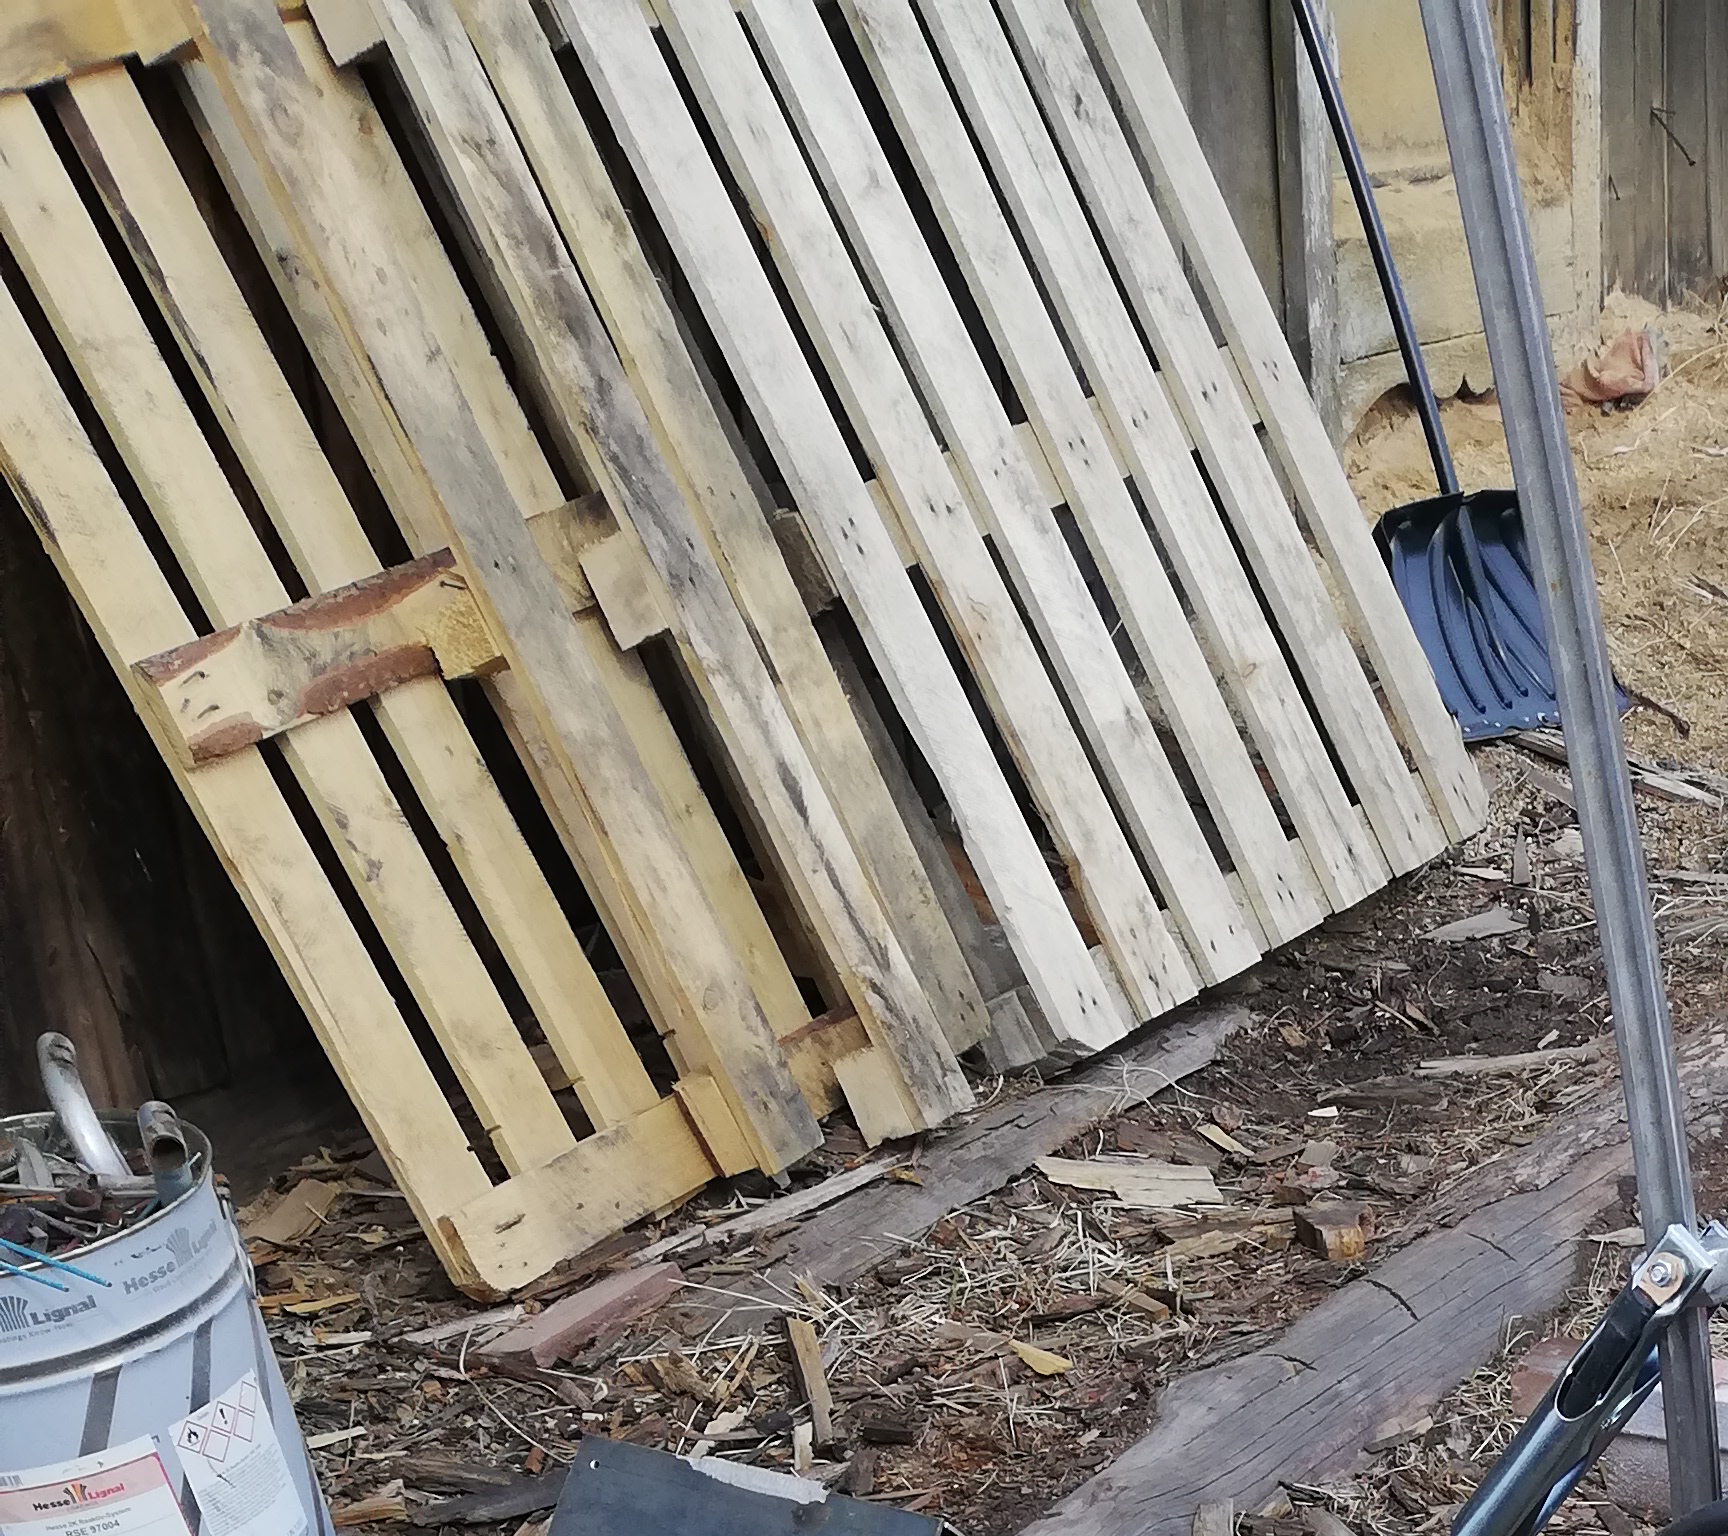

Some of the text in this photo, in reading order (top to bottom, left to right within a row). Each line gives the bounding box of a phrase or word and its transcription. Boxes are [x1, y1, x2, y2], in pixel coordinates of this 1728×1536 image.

[122, 1260, 176, 1295] Hesse
[29, 1295, 97, 1326] Lignal
[32, 1499, 71, 1512] Hesse
[87, 1482, 125, 1500] Lignal
[89, 1519, 121, 1534] 97004
